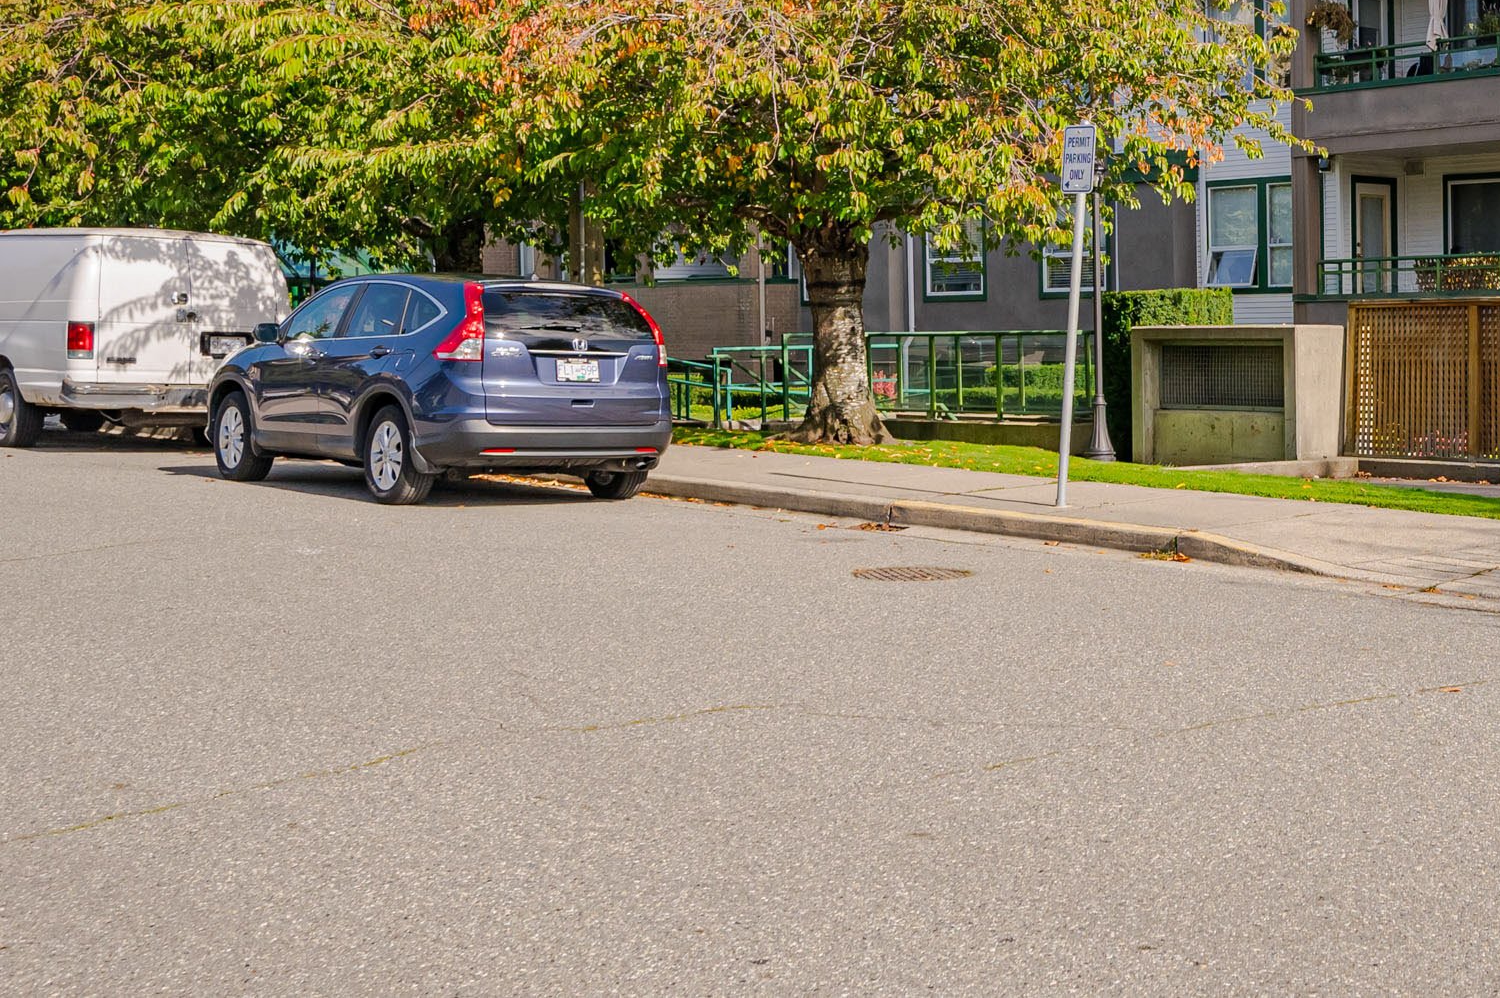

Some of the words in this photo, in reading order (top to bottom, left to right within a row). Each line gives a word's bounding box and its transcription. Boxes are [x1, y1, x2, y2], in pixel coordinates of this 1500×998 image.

[1068, 137, 1091, 147] PERMIT
[1065, 153, 1092, 163] PARKING
[1070, 169, 1085, 180] ONLY
